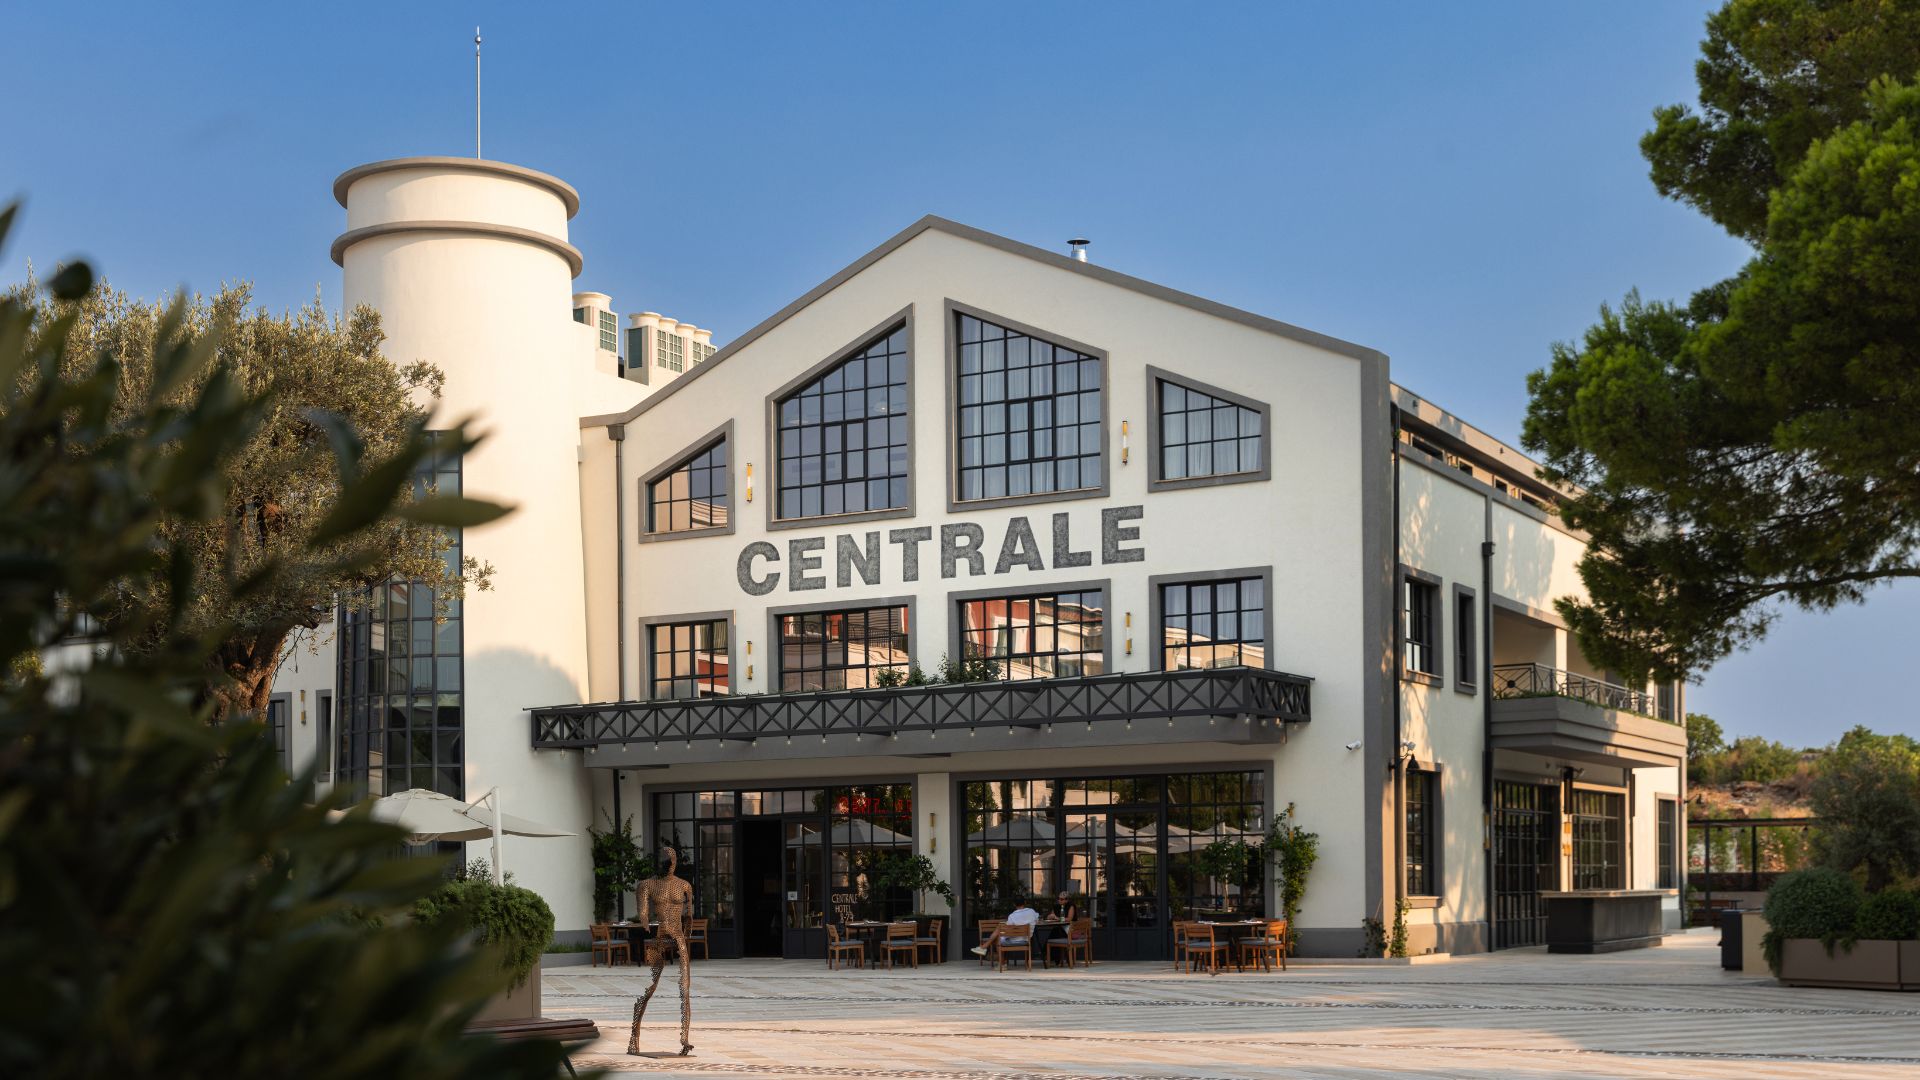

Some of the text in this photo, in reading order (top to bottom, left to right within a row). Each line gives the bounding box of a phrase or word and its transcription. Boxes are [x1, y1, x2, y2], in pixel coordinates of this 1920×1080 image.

[736, 504, 1146, 597] CENTRALE
[831, 893, 858, 904] CENTRALE
[835, 904, 851, 913] HOTEL
